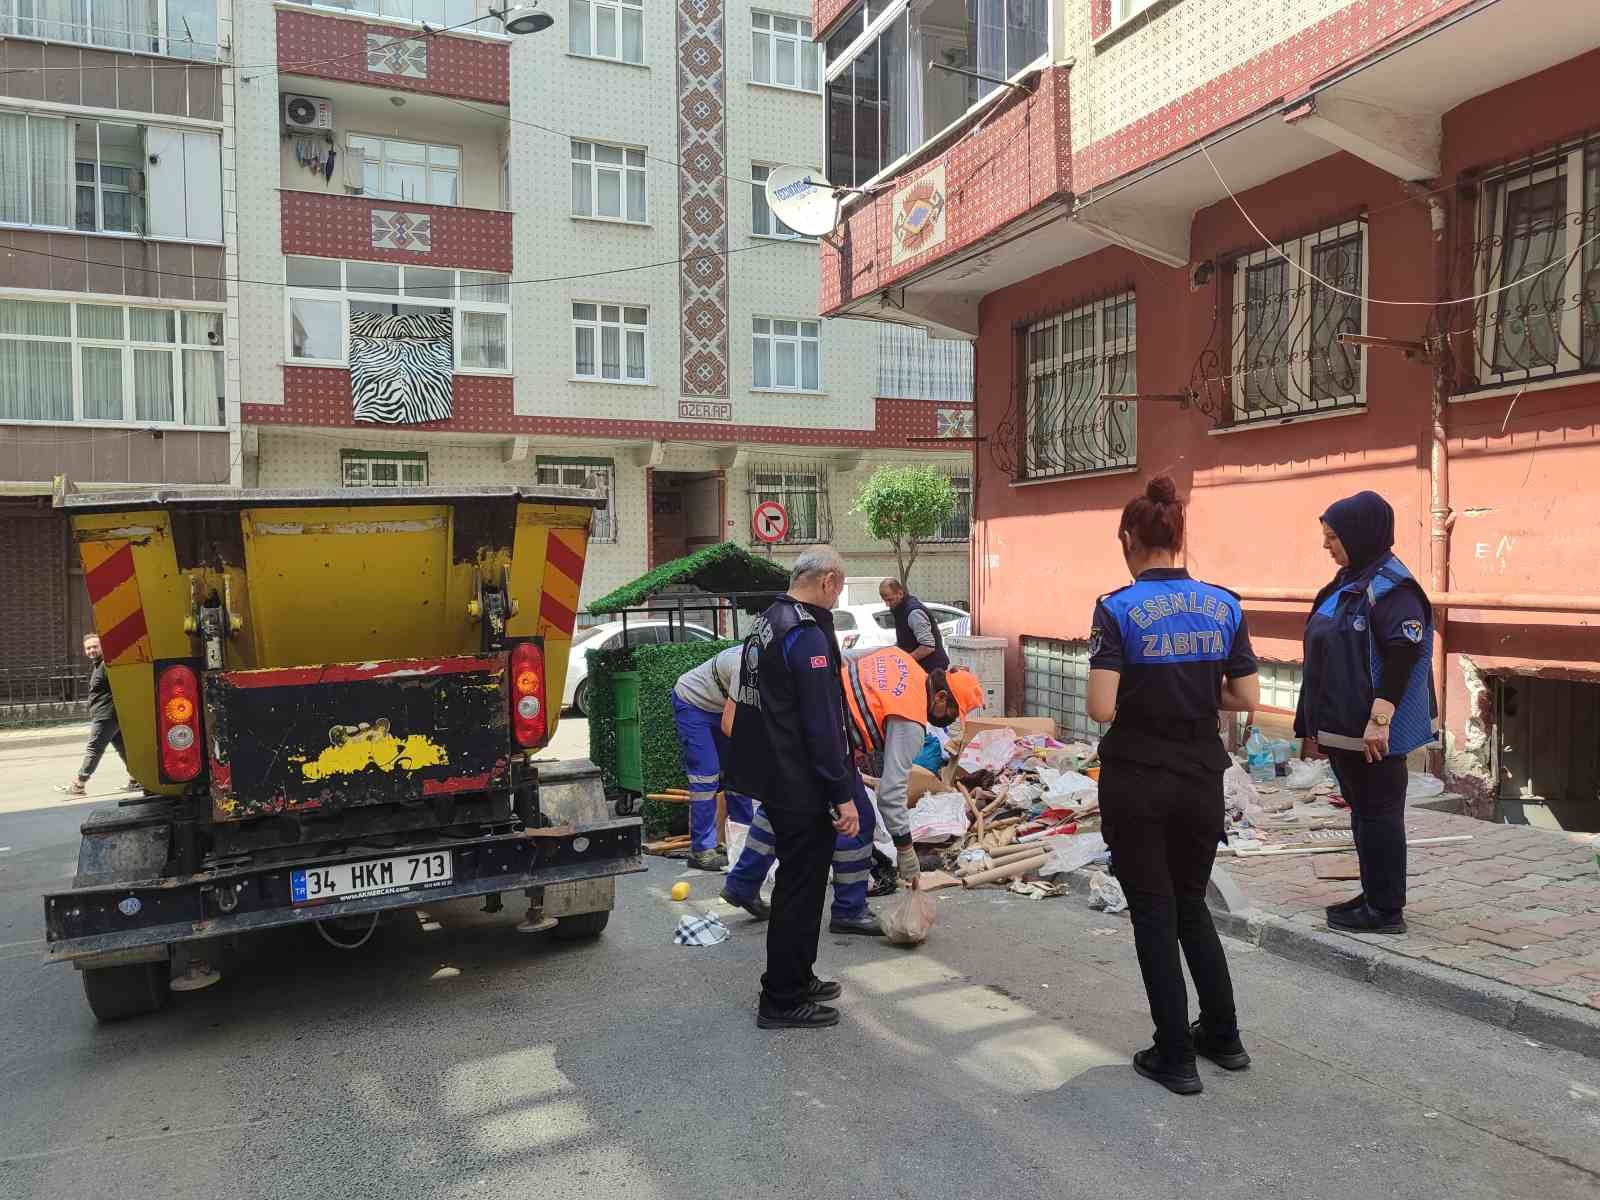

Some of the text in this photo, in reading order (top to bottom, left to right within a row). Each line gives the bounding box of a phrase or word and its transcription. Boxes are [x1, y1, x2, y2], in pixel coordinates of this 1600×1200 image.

[1128, 592, 1230, 629] ESENLER
[1142, 631, 1224, 657] ZABITA
[308, 855, 445, 895] 34 HKM 713
[295, 887, 306, 896] TR
